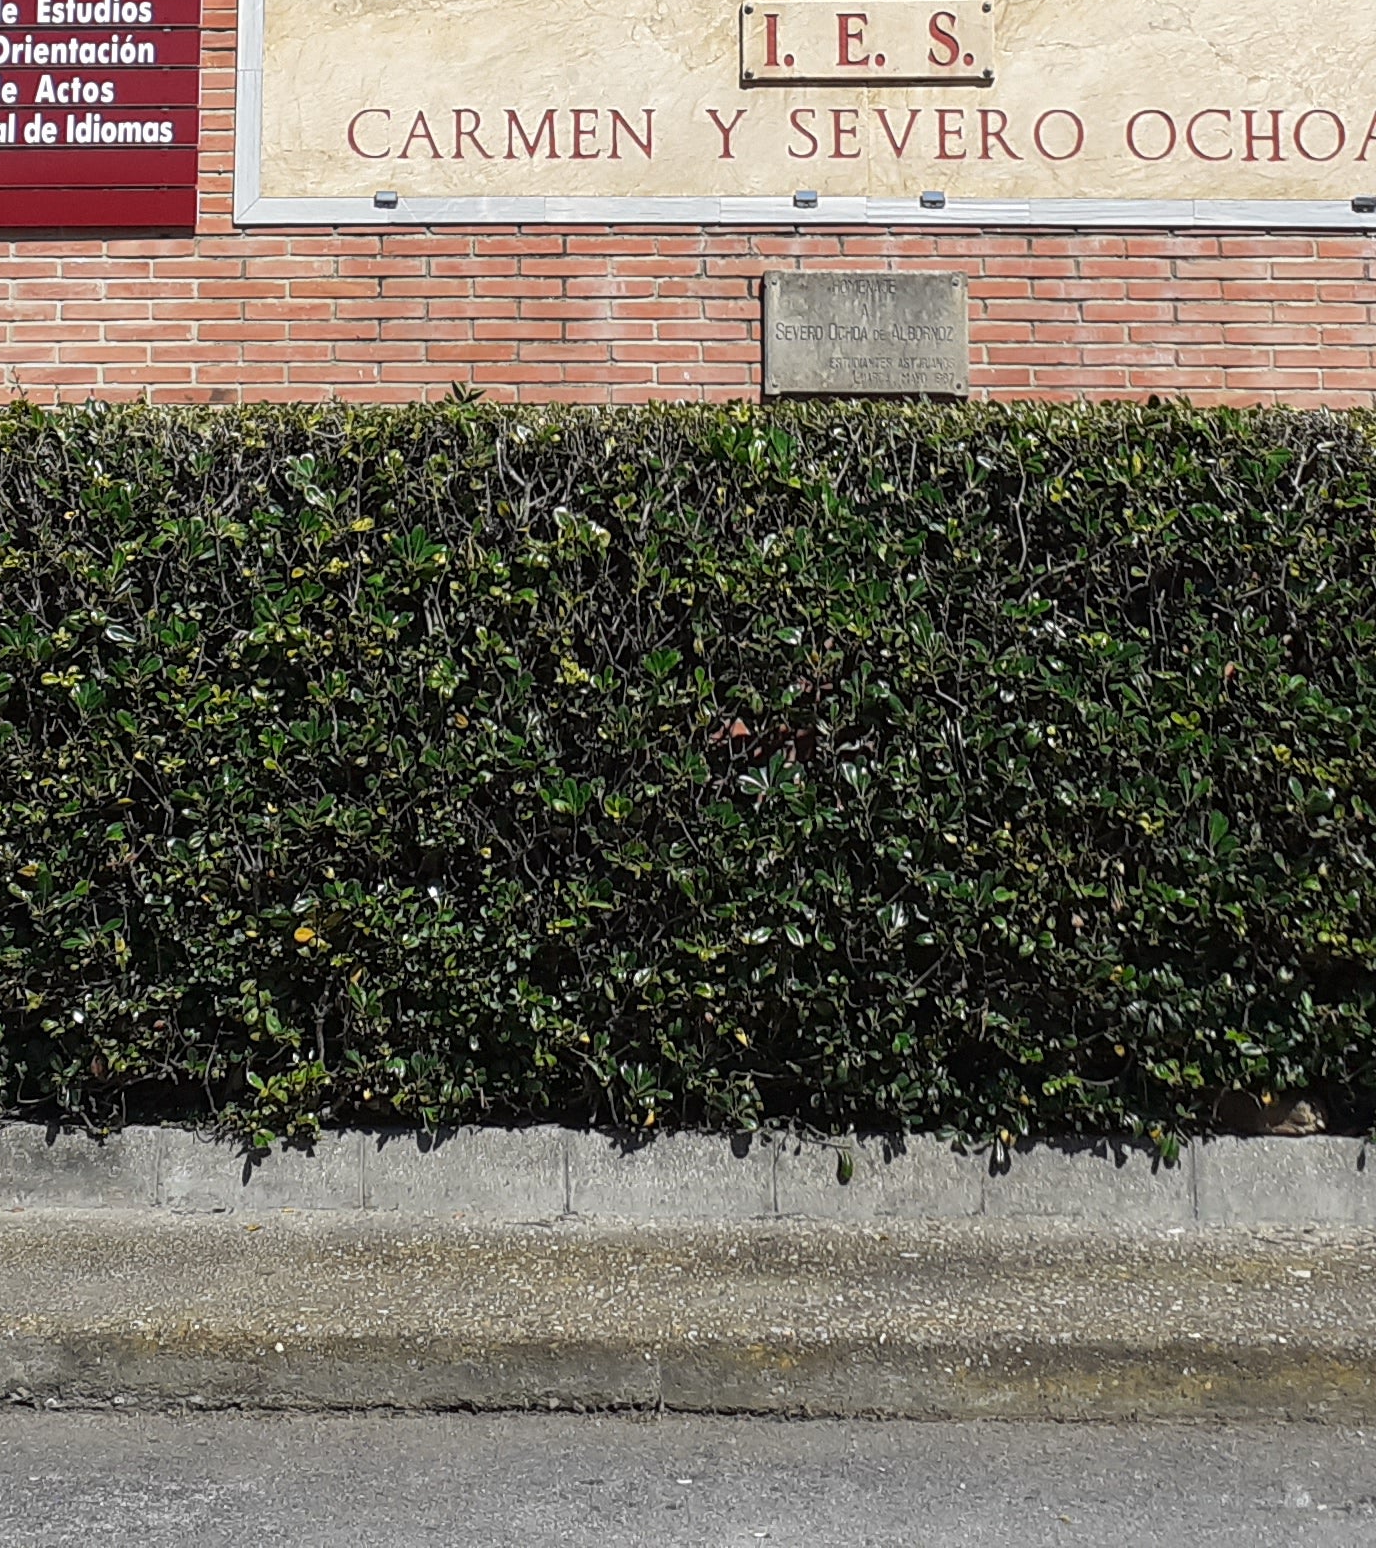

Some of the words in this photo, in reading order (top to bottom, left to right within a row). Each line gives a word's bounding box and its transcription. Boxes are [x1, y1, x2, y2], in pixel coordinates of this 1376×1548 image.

[761, 13, 797, 69] I.
[835, 13, 886, 68] E.
[926, 12, 977, 67] S.
[35, 74, 115, 104] Actos
[24, 115, 57, 144] de
[66, 114, 173, 143] Idiomas
[346, 107, 654, 162] CARMEN
[706, 108, 747, 159] Y
[787, 106, 1085, 161] SEVERO
[832, 279, 896, 295] HOMENAJE
[775, 323, 823, 341] SEVERO
[829, 323, 868, 341] OCHOA
[874, 330, 886, 340] DE
[892, 324, 954, 341] ALBORNOZ
